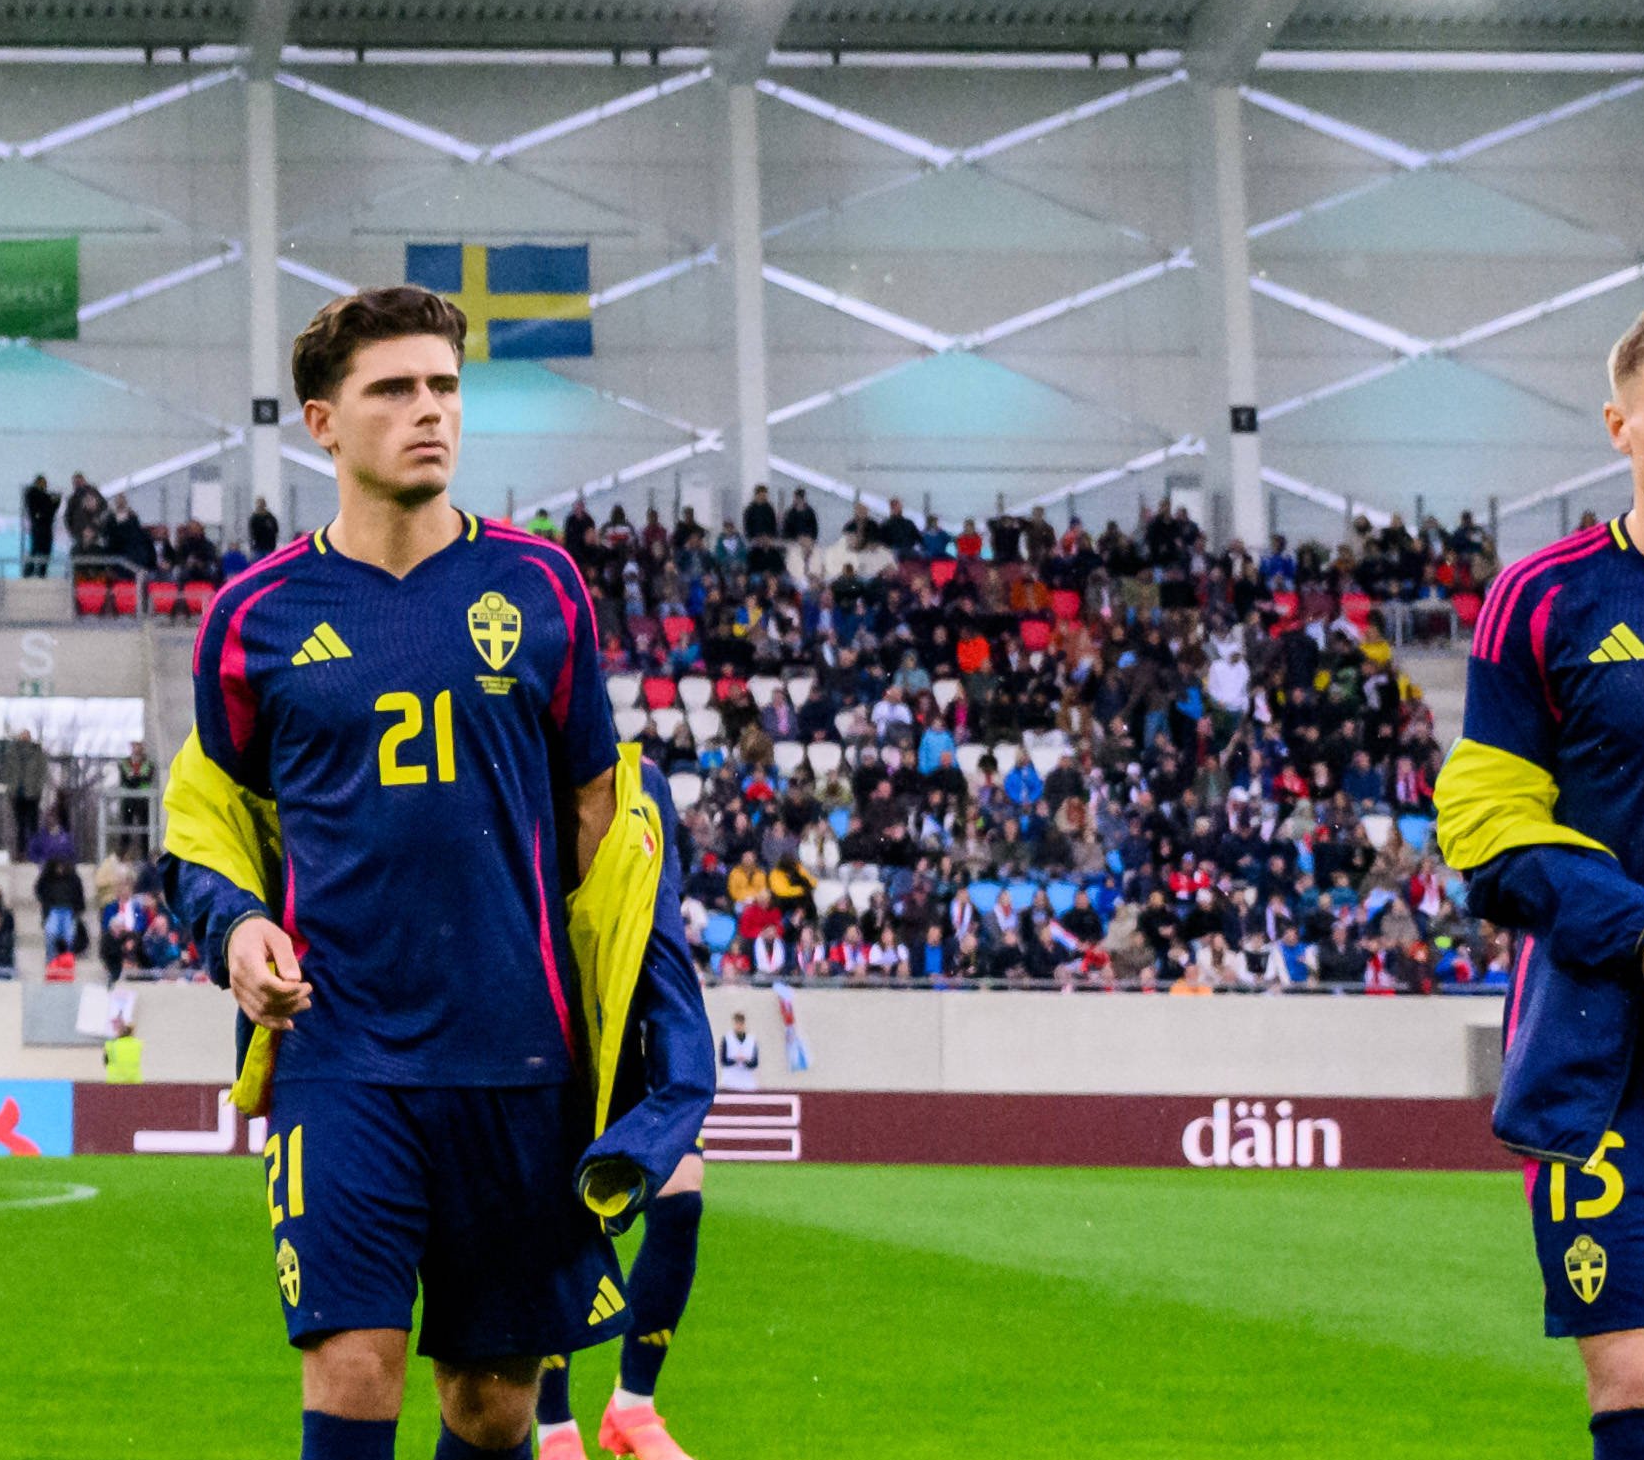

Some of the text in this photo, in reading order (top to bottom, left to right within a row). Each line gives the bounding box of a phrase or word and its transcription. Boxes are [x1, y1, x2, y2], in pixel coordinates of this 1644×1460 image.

[374, 689, 456, 786] 21
[264, 1124, 305, 1231] 21
[1181, 1097, 1343, 1168] däin
[1550, 1130, 1626, 1222] 15
